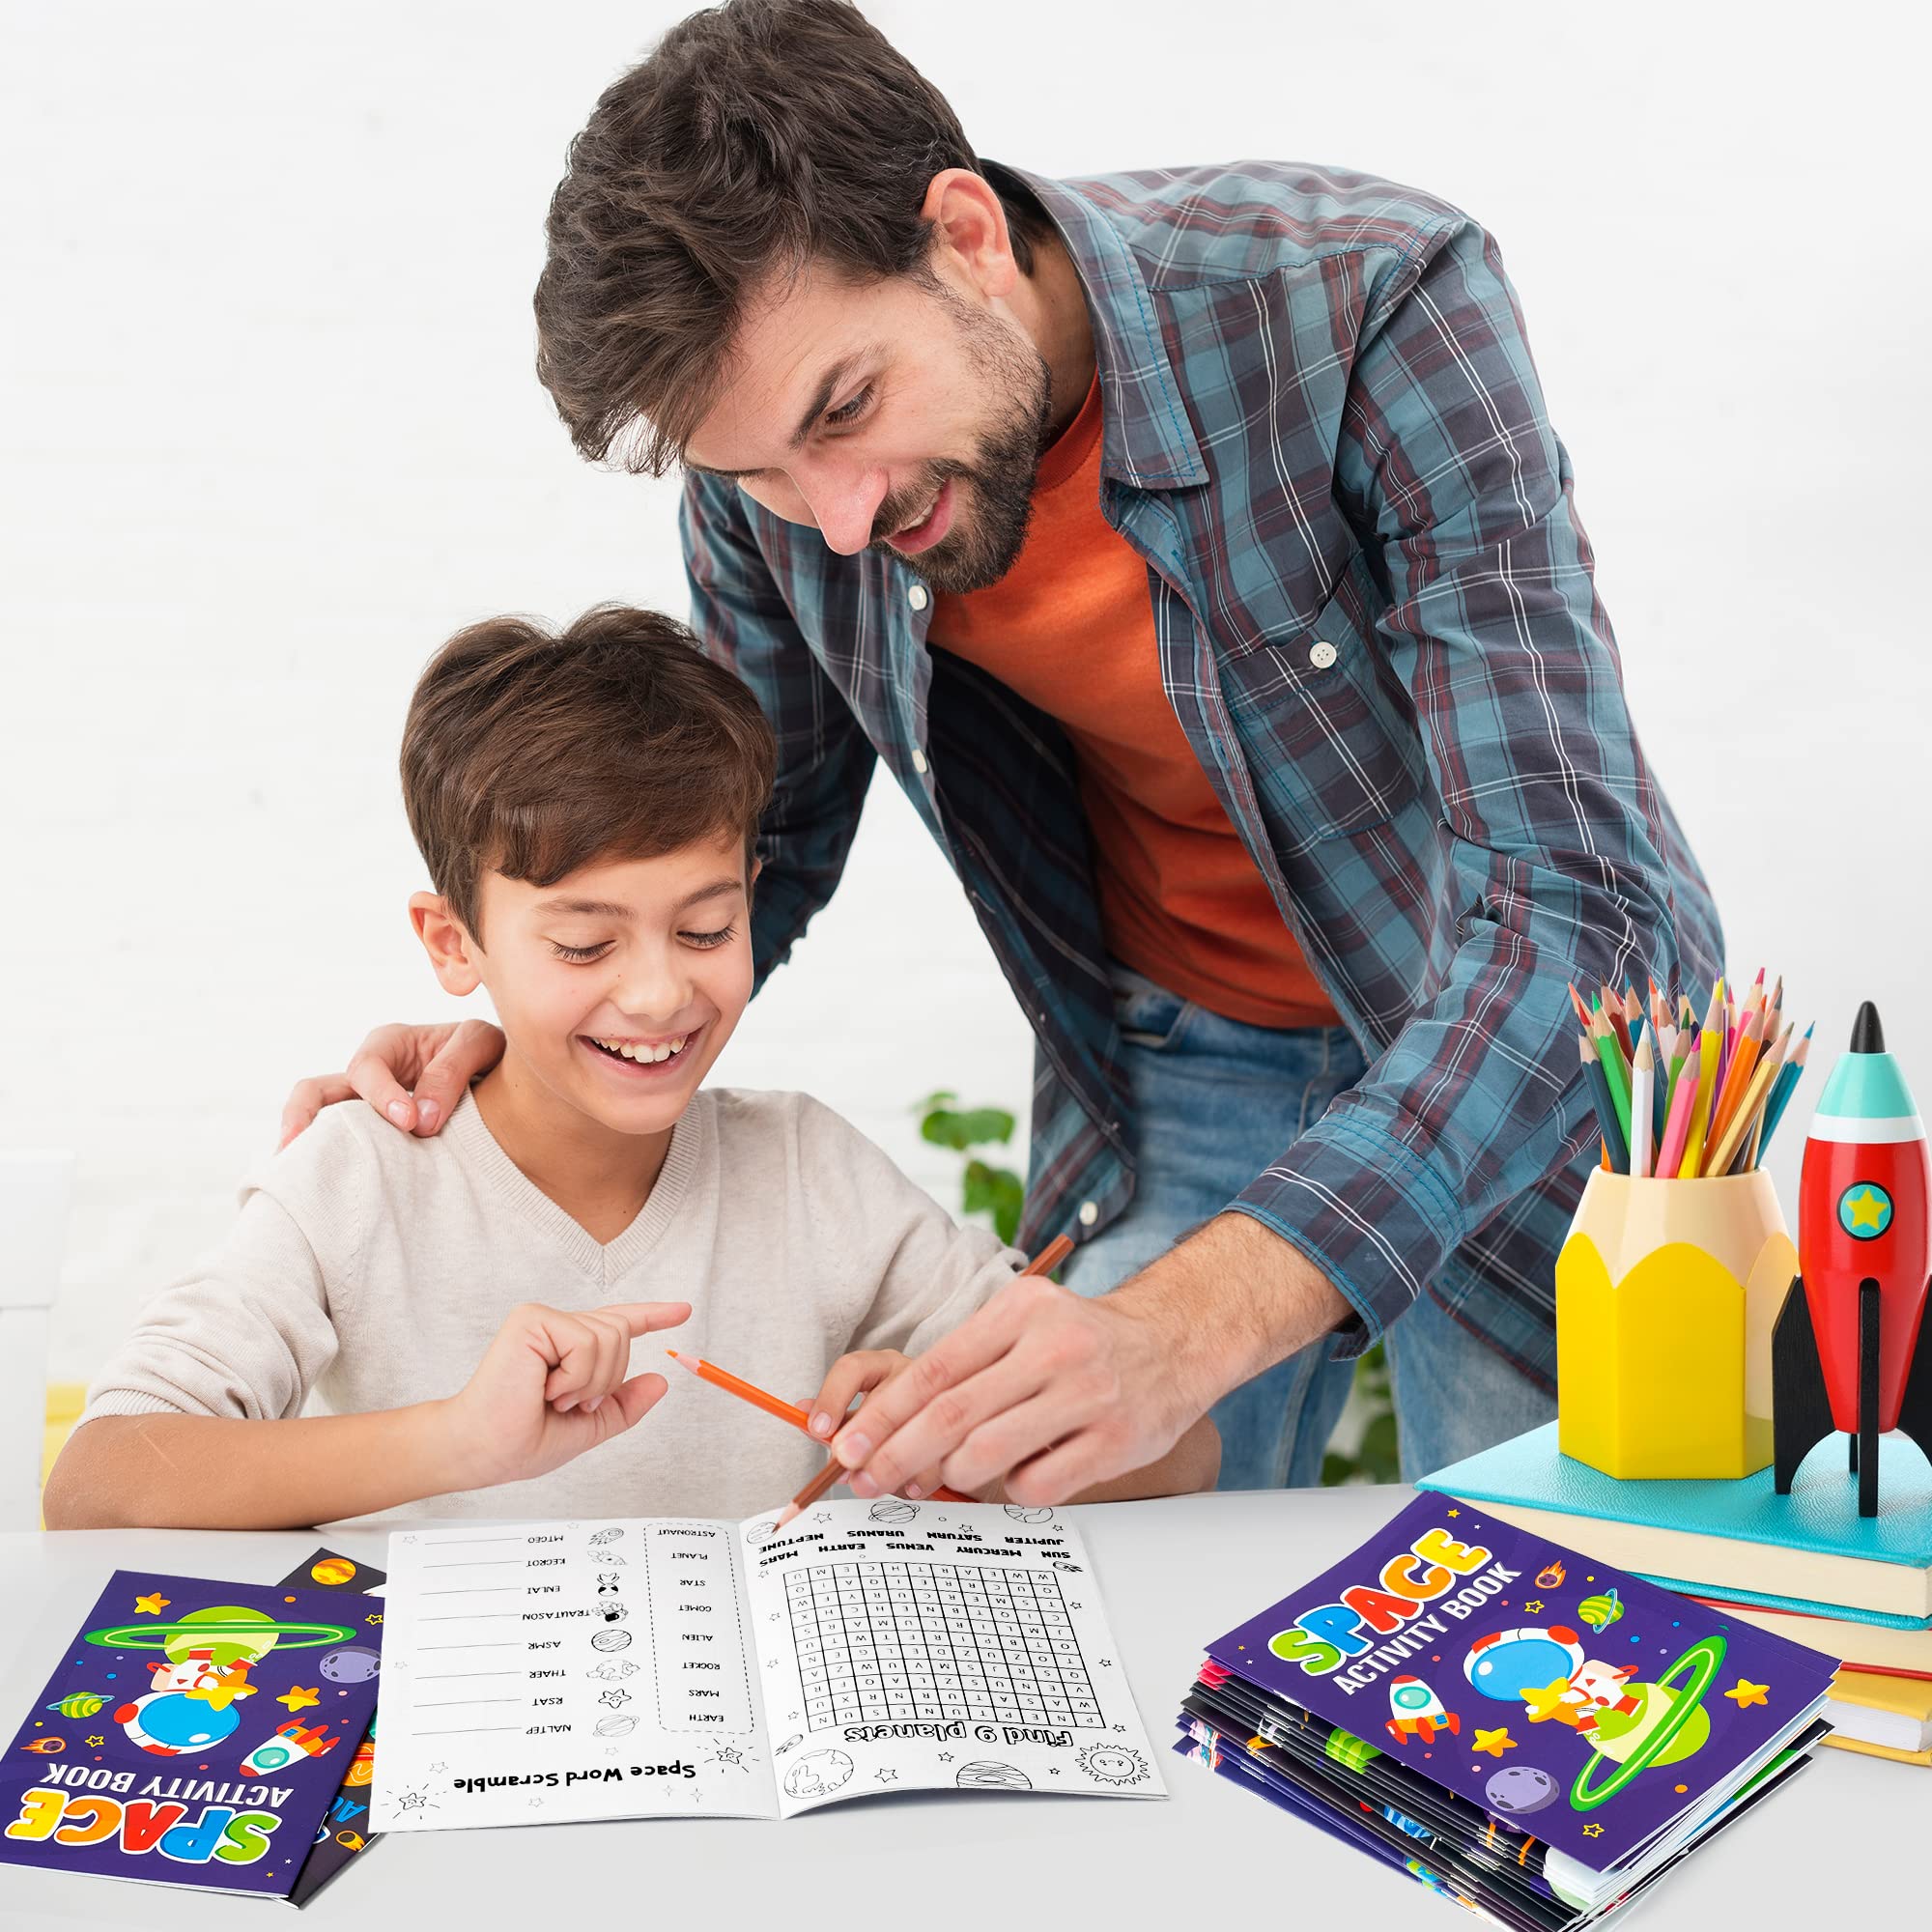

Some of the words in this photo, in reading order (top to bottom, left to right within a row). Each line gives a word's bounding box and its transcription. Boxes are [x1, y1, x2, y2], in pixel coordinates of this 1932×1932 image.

[657, 1528, 716, 1538] ASTRONAUT
[846, 1529, 905, 1538] URANUS
[926, 1531, 983, 1542] SATURN
[527, 1535, 564, 1544] MTCEO
[758, 1532, 824, 1554] NEPTUNE
[1004, 1536, 1065, 1546] JUPITER
[817, 1543, 867, 1552] EARTH
[885, 1542, 935, 1551] VENUS
[955, 1546, 1023, 1557] MERCURY
[759, 1549, 799, 1568] MARS
[759, 1549, 799, 1568] MARS
[1040, 1550, 1071, 1559] SUN
[526, 1557, 566, 1568] KECROT
[526, 1585, 560, 1595] ENLAI
[1268, 1528, 1492, 1676] SPACE
[678, 1605, 712, 1613] COMET
[522, 1609, 590, 1621] TRAUTASON
[1332, 1613, 1449, 1695] ACTIVITY
[1439, 1561, 1522, 1620] BOOK
[682, 1634, 714, 1642] ALIEN
[527, 1640, 561, 1651] ASMR
[682, 1662, 721, 1670] ROCKET
[528, 1669, 566, 1679] THAER
[531, 1697, 563, 1707] RSAT
[689, 1714, 724, 1722] EARTH
[526, 1724, 572, 1735] NALTEP
[843, 1719, 969, 1743] planets
[974, 1725, 997, 1744] 9
[1003, 1726, 1075, 1747] Find
[630, 1759, 696, 1778] Space
[40, 1762, 135, 1792] BOOK
[565, 1768, 623, 1787] Word
[453, 1773, 559, 1794] Scramble
[140, 1777, 294, 1808] ACTIVITY
[5, 1787, 282, 1865] SPACE
